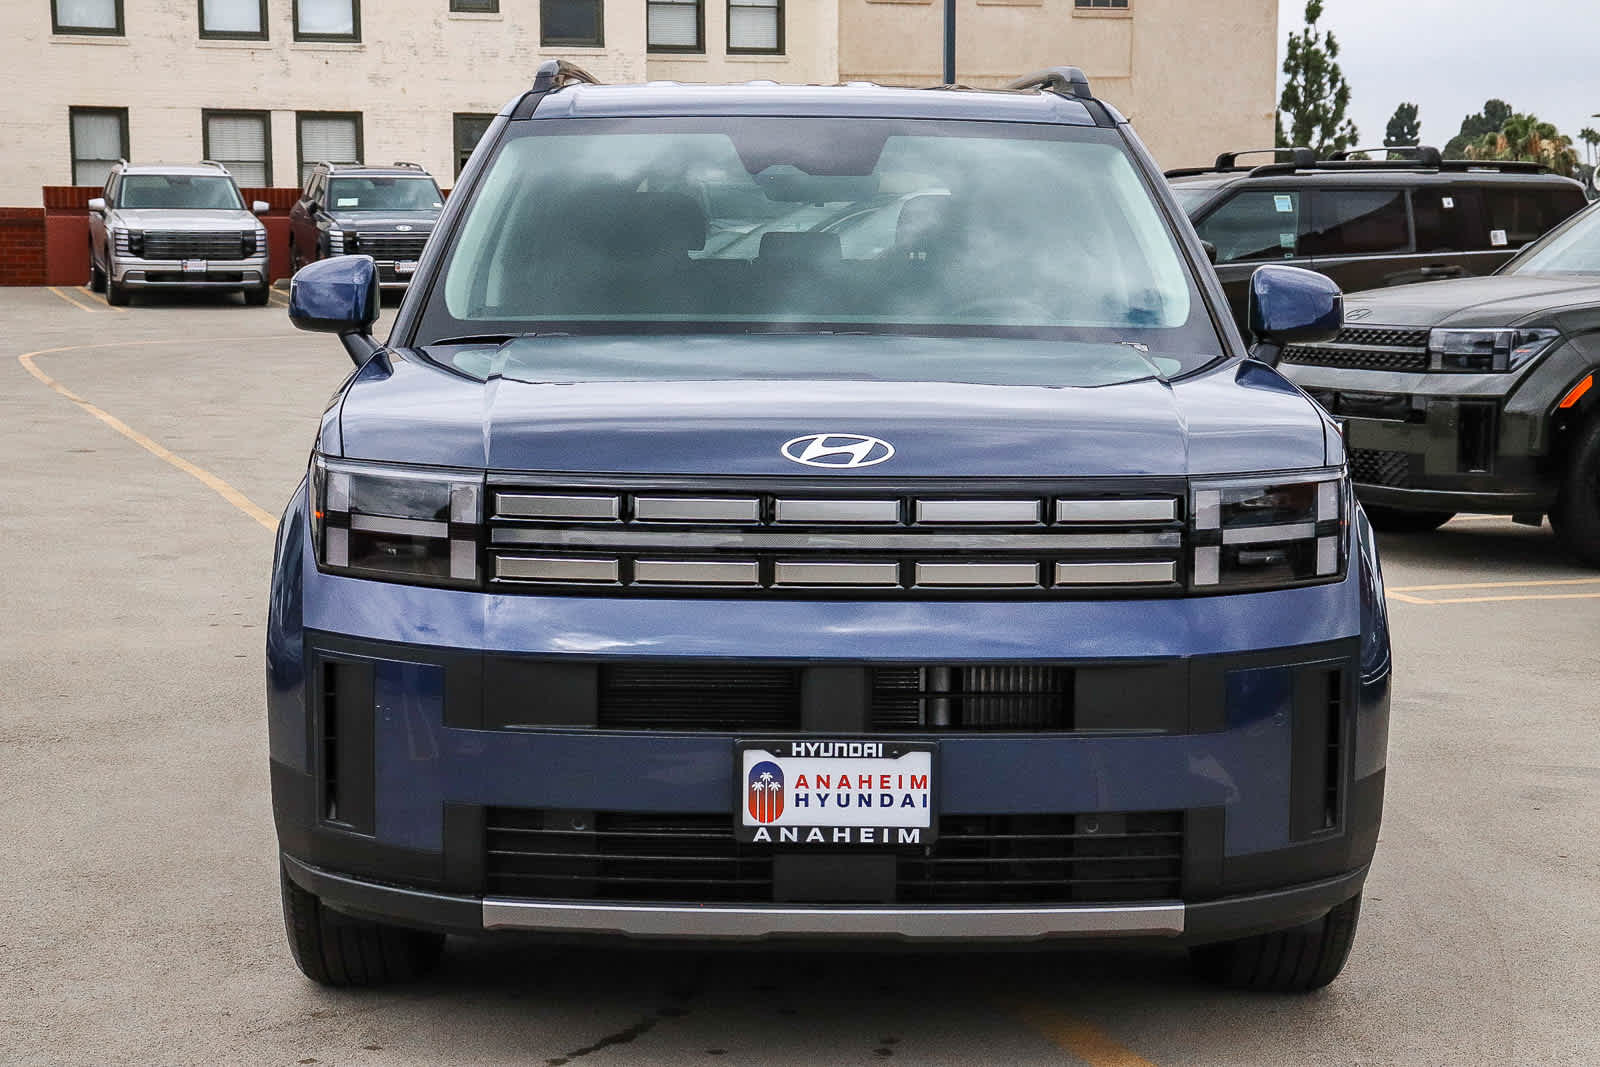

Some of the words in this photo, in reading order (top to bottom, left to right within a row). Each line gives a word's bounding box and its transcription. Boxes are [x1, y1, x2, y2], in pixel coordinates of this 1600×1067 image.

[791, 742, 883, 757] HYUNDAI
[794, 774, 928, 790] ANAHEIM
[794, 793, 928, 808] HYUNDAI
[752, 827, 920, 844] ANAHEIM
